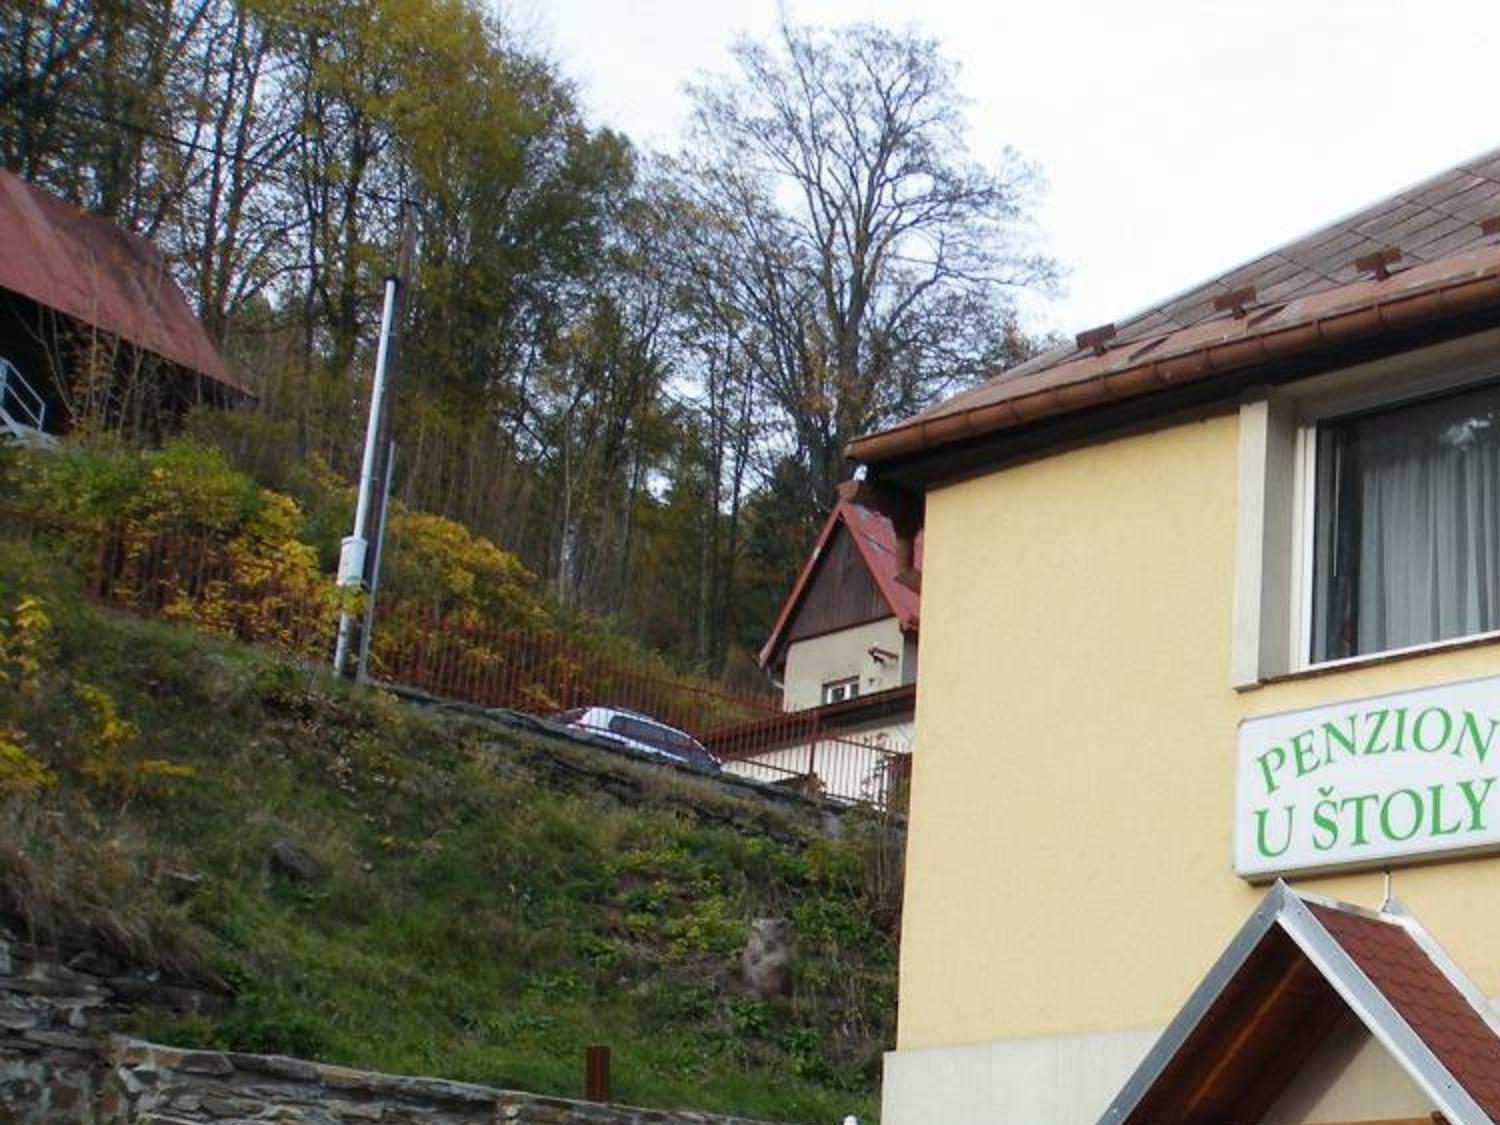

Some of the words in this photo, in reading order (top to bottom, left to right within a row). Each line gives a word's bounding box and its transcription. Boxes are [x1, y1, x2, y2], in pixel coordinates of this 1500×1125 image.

[1256, 706, 1500, 796] PENZION
[1253, 806, 1296, 858] U
[1312, 777, 1497, 851] ŠTOLY
